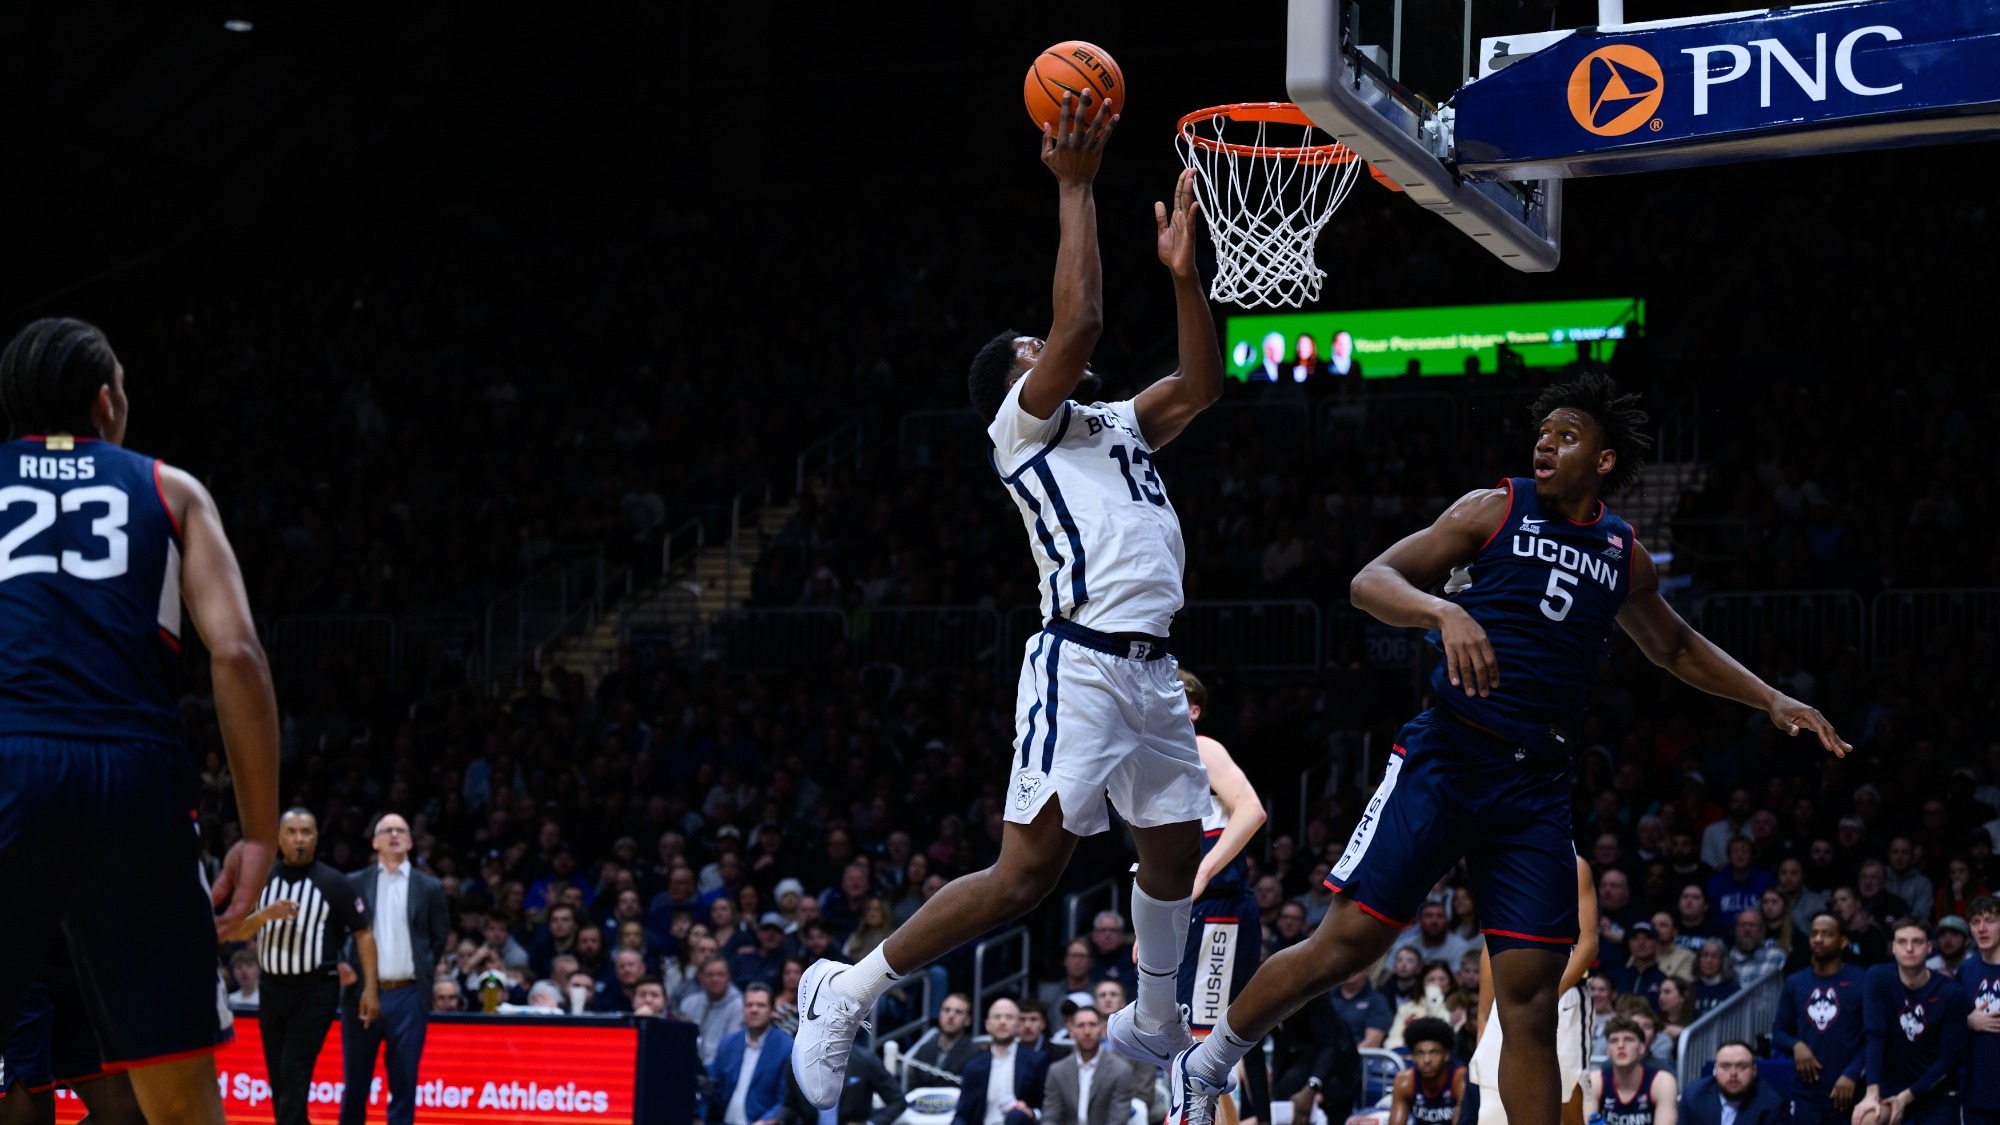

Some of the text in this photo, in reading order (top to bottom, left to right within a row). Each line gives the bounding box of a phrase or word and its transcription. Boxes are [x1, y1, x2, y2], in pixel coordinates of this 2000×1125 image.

[1071, 46, 1116, 92] ELITE
[1680, 25, 1903, 116] PNC
[1353, 338, 1388, 353] Your
[1390, 335, 1458, 352] Personal
[19, 455, 96, 480] ROSS
[1109, 445, 1166, 507] 13
[0, 485, 129, 582] 23
[1512, 535, 1619, 592] UCONN
[1539, 567, 1579, 622] 5
[1135, 644, 1146, 659] B
[1366, 637, 1406, 661] 206
[1204, 931, 1227, 1019] HUSKIES
[477, 1081, 609, 1113] Athletics
